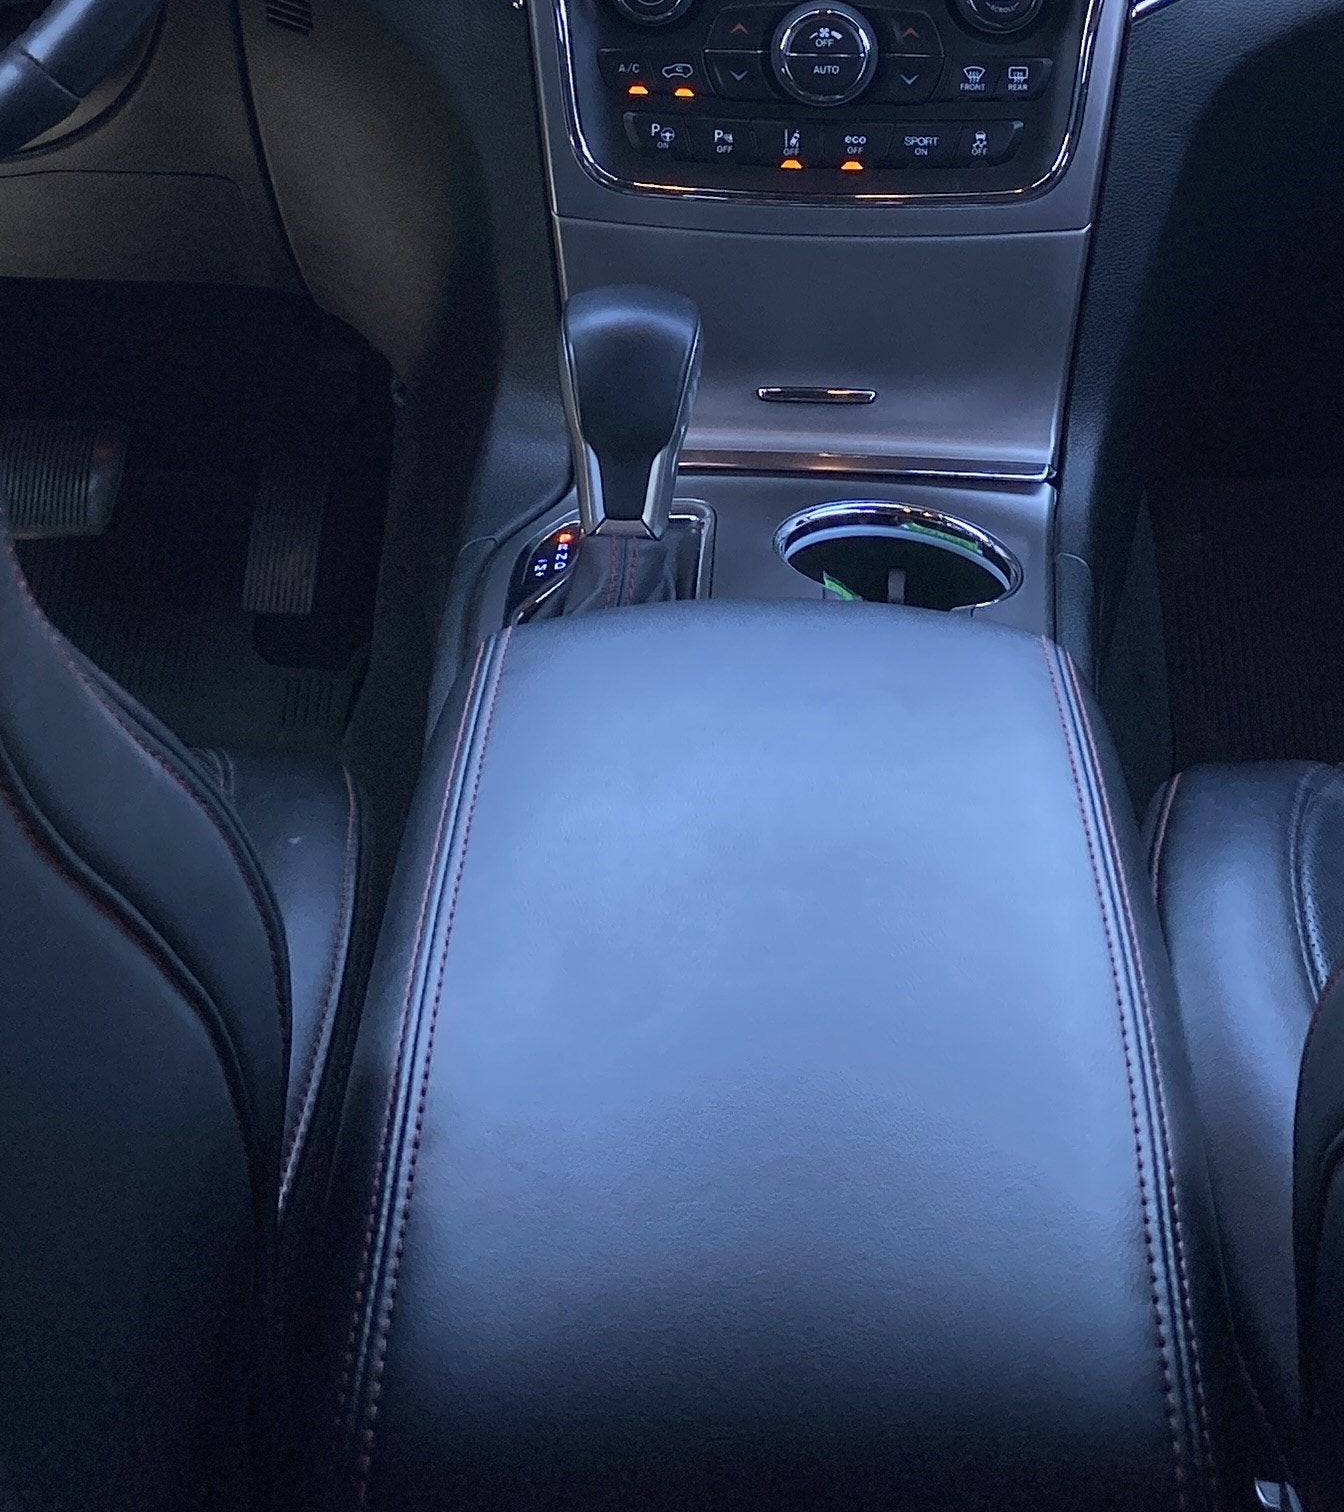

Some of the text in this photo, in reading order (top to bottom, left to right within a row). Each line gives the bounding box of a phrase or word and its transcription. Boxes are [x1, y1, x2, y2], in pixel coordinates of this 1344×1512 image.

[990, 4, 1015, 13] SCROLL
[815, 39, 834, 48] OFF
[618, 63, 640, 74] A/C
[813, 65, 840, 74] AUTO
[960, 83, 985, 91] FRONT
[1008, 84, 1029, 92] REAR
[651, 124, 660, 137] P
[714, 129, 723, 143] P
[844, 135, 867, 145] eco
[904, 136, 939, 147] SPORT
[716, 145, 733, 154] OFF
[783, 148, 800, 156] OFF
[847, 146, 864, 155] OFF
[915, 148, 928, 156] ON
[971, 147, 988, 156] OFF
[555, 552, 568, 560] N
[534, 563, 548, 572] M
[554, 562, 566, 570] D
